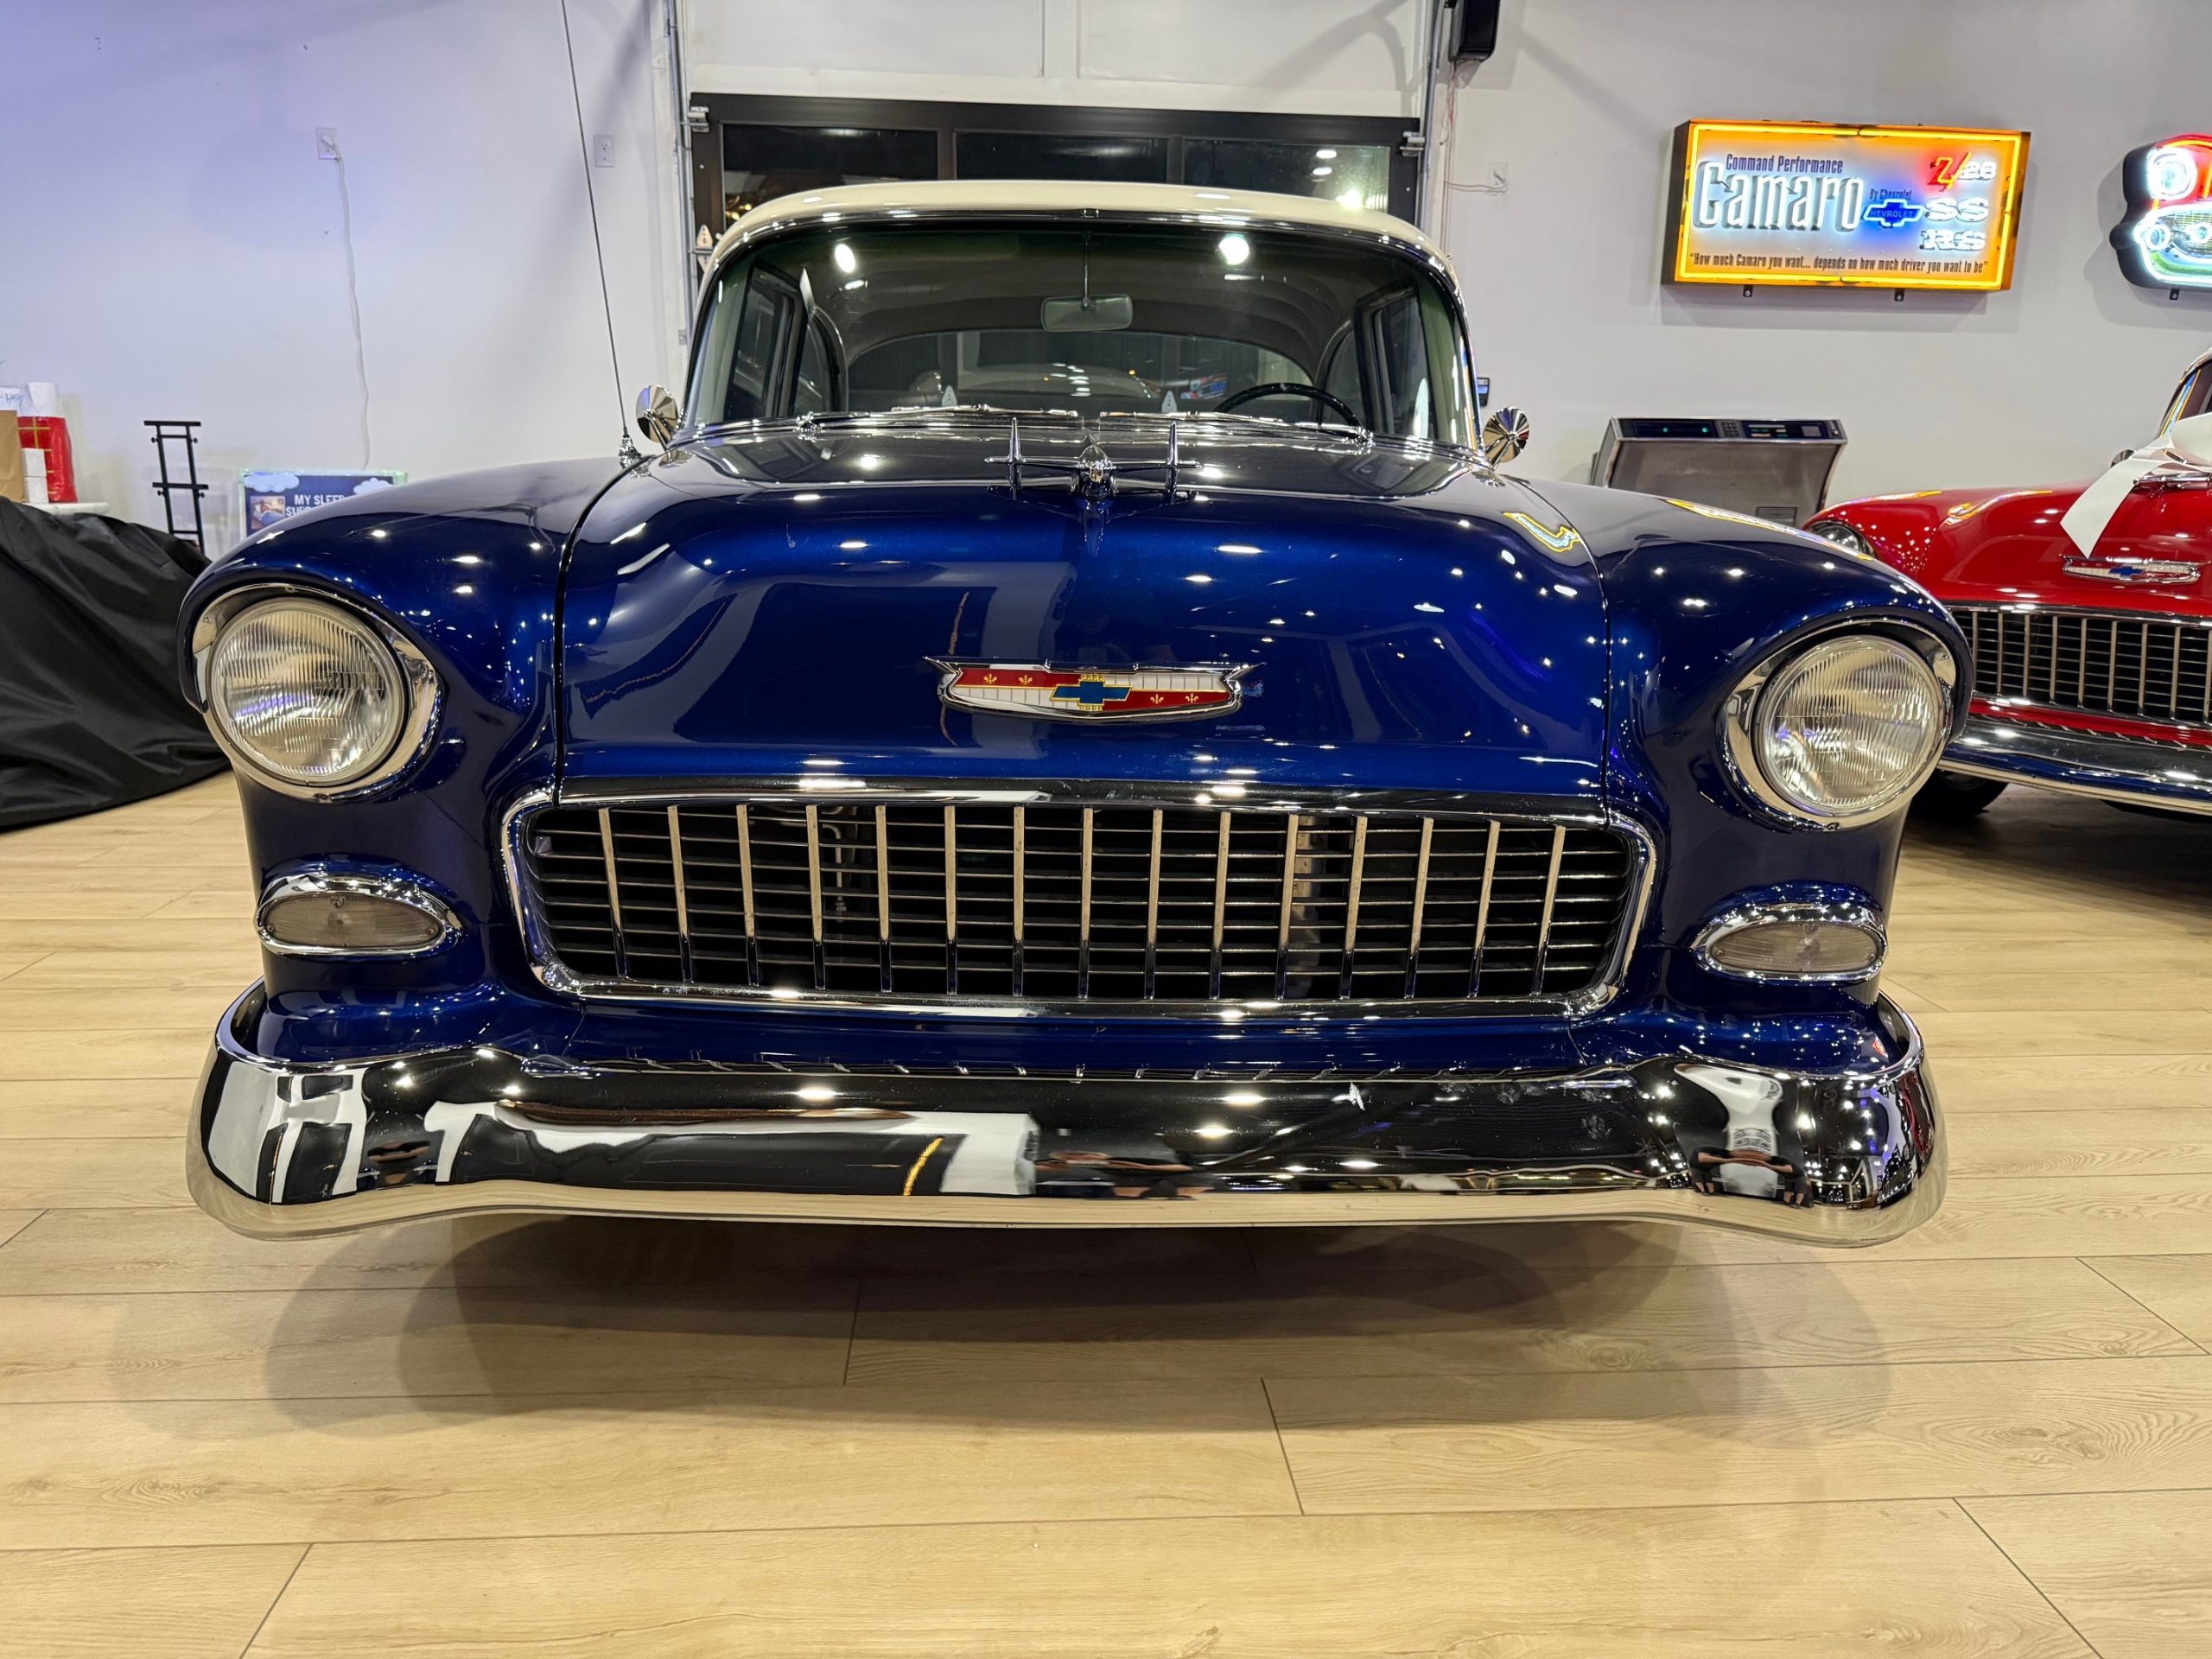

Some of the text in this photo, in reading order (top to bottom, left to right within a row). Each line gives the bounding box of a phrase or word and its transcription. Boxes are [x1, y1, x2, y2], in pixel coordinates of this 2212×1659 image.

[1726, 154, 1843, 174] Command Performance
[1693, 161, 1864, 232] Camaro
[1870, 188, 1912, 201] By Chevrolet
[1924, 197, 1988, 222] SS
[1920, 229, 1986, 251] RS
[1713, 254, 1733, 266] much
[1736, 254, 1766, 267] Camaro
[1768, 257, 1783, 269] you
[1814, 256, 1846, 270] depends
[1847, 258, 1858, 270] on
[1859, 257, 1876, 270] how
[1878, 258, 1898, 270] much
[1900, 258, 1925, 272] driver
[1927, 262, 1941, 274] you
[1943, 261, 1962, 273] want
[1964, 261, 1972, 273] to
[295, 494, 311, 505] MY
